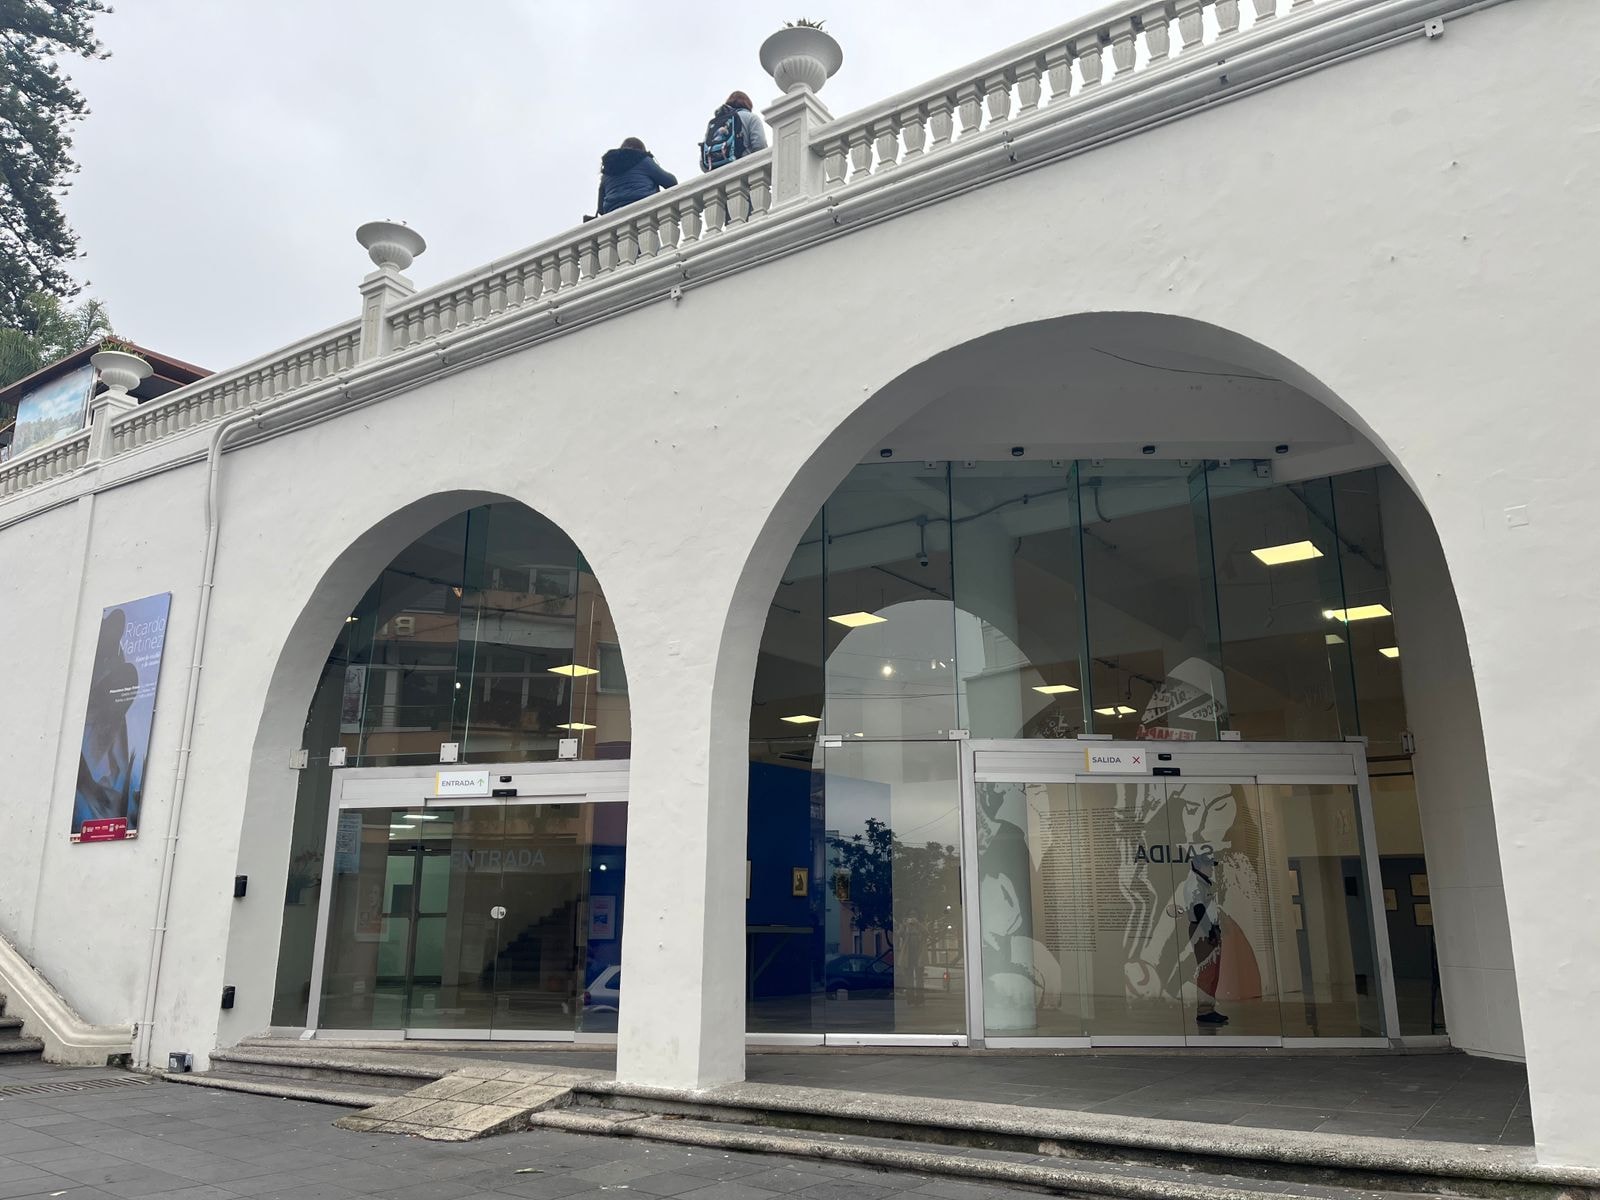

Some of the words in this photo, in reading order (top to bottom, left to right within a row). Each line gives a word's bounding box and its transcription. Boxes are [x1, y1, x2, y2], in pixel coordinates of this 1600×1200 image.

[125, 616, 166, 637] Ricardo
[1092, 756, 1121, 764] SALIDA
[441, 779, 475, 787] ENTRADA
[452, 848, 545, 868] ENTRADA
